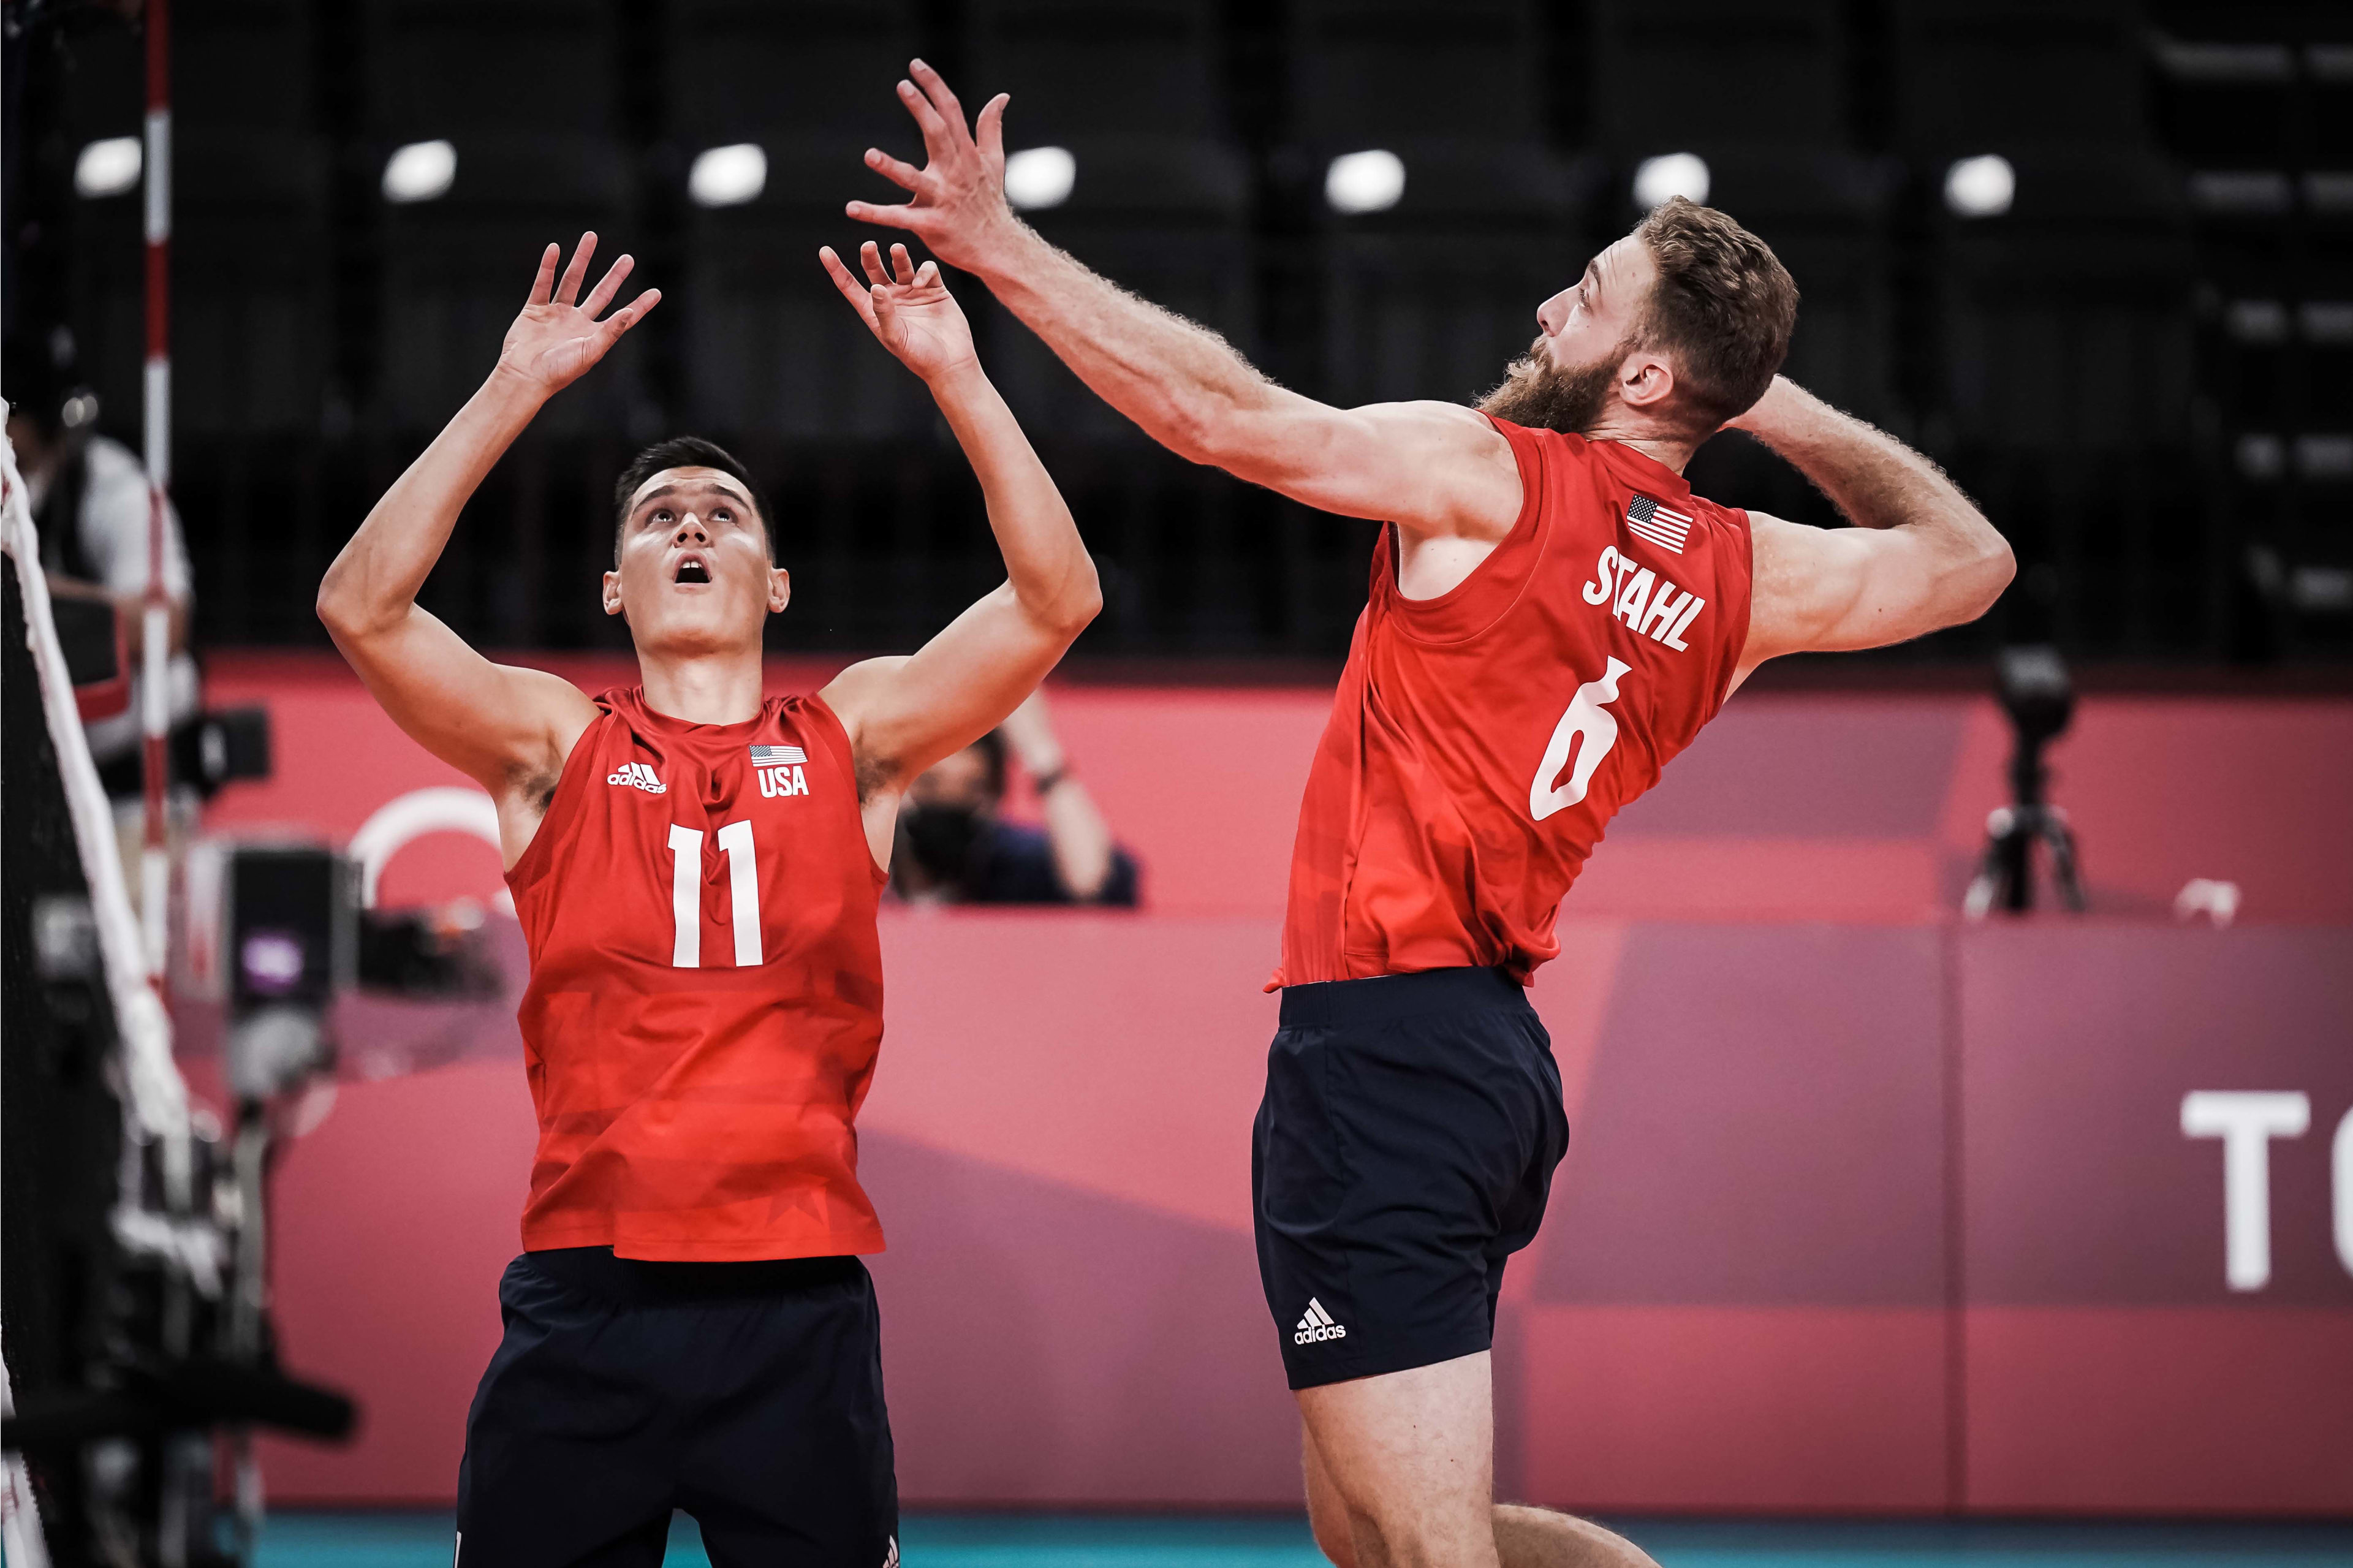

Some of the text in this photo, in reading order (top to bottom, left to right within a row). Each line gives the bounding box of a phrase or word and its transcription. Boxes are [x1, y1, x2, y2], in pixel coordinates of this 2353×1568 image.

[1582, 545, 1705, 652] STAHL
[607, 771, 667, 793] adidas
[757, 765, 809, 798] USA
[1529, 655, 1632, 821] 6
[667, 819, 763, 968] 11
[2180, 1089, 2353, 1292] T
[1294, 1324, 1346, 1345] adidas
